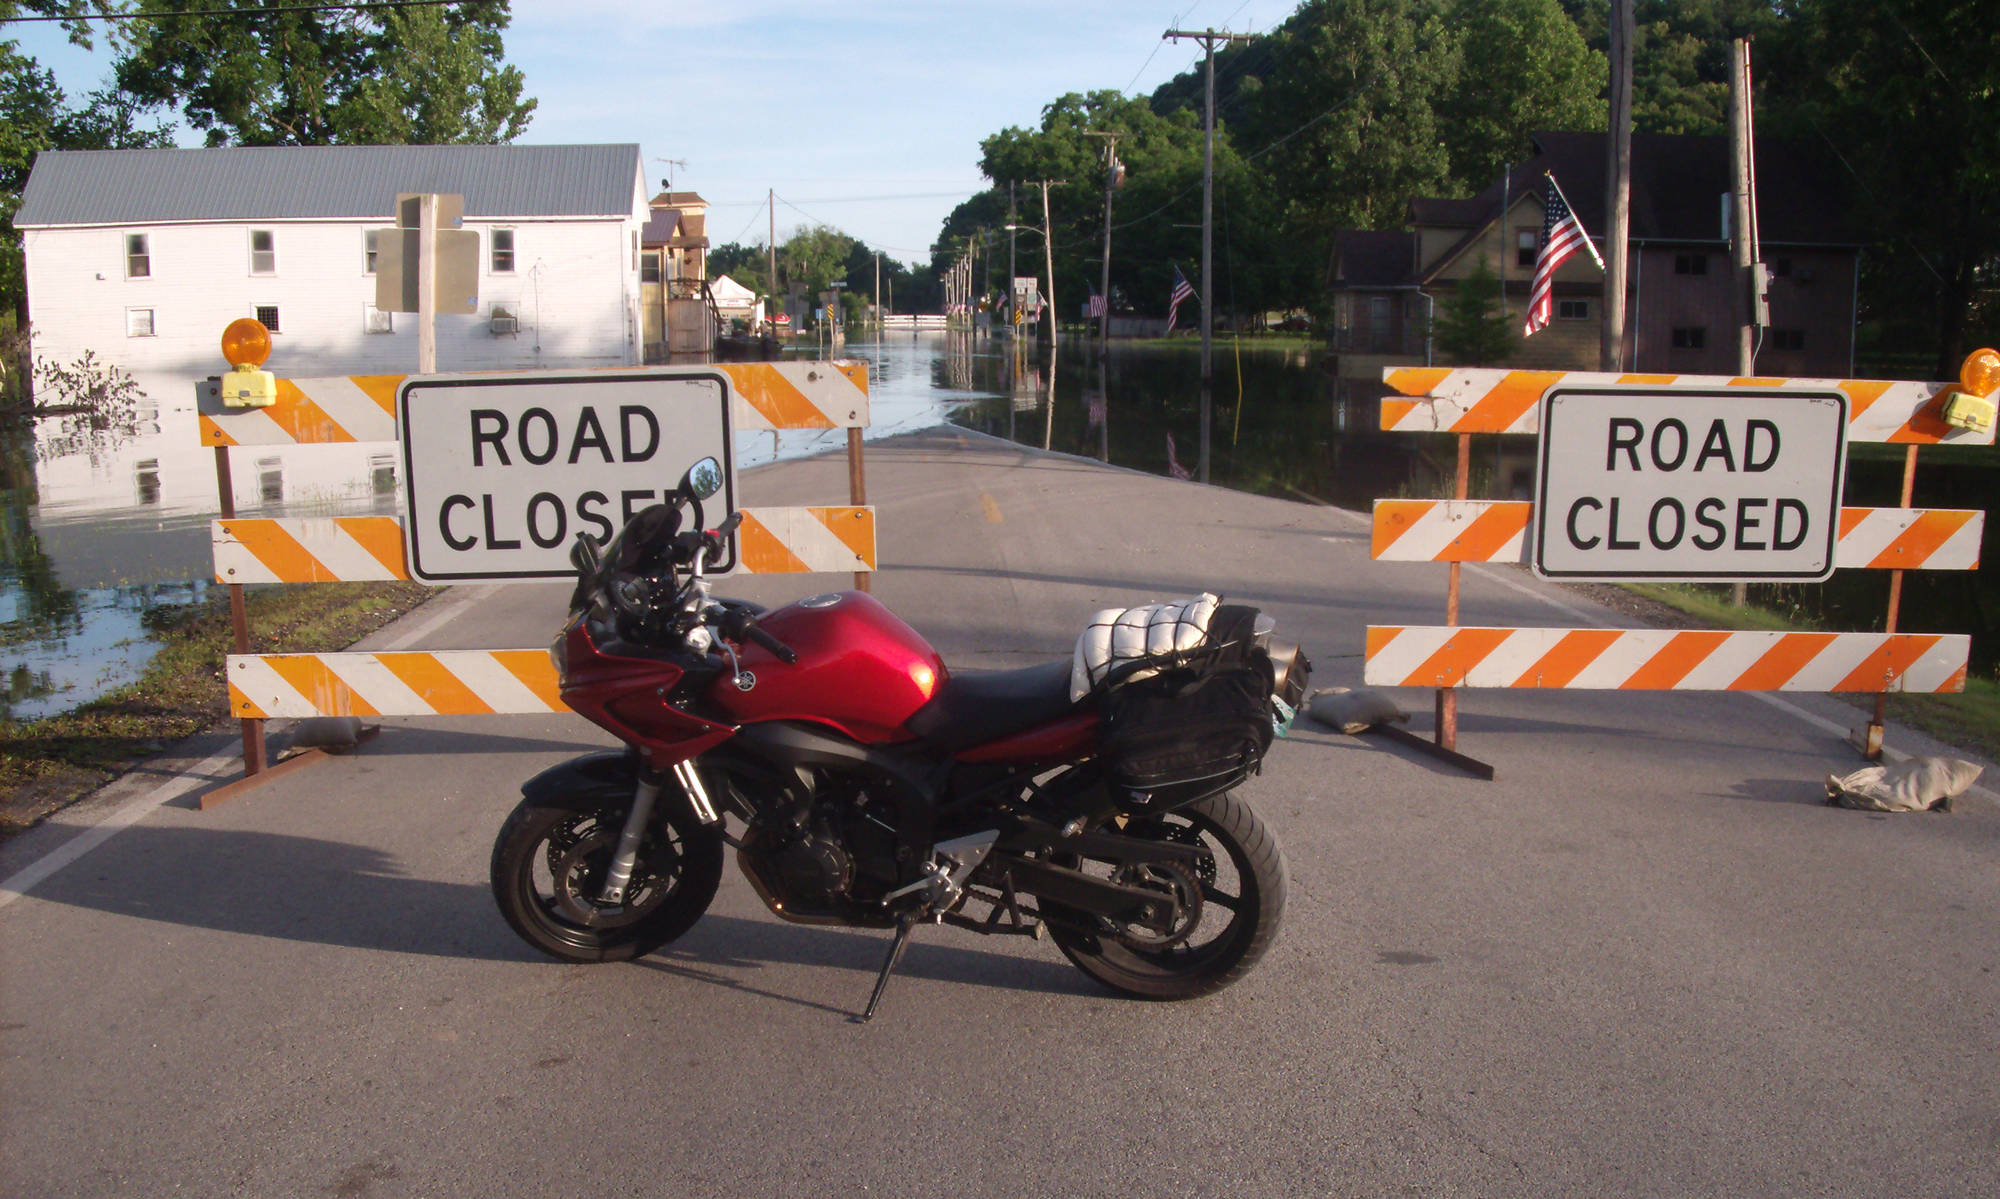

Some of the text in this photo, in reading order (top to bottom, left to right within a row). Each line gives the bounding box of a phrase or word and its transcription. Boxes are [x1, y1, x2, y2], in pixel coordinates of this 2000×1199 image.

[470, 404, 661, 467] ROAD
[1606, 417, 1781, 473] ROAD
[1566, 496, 1810, 551] CLOSED
